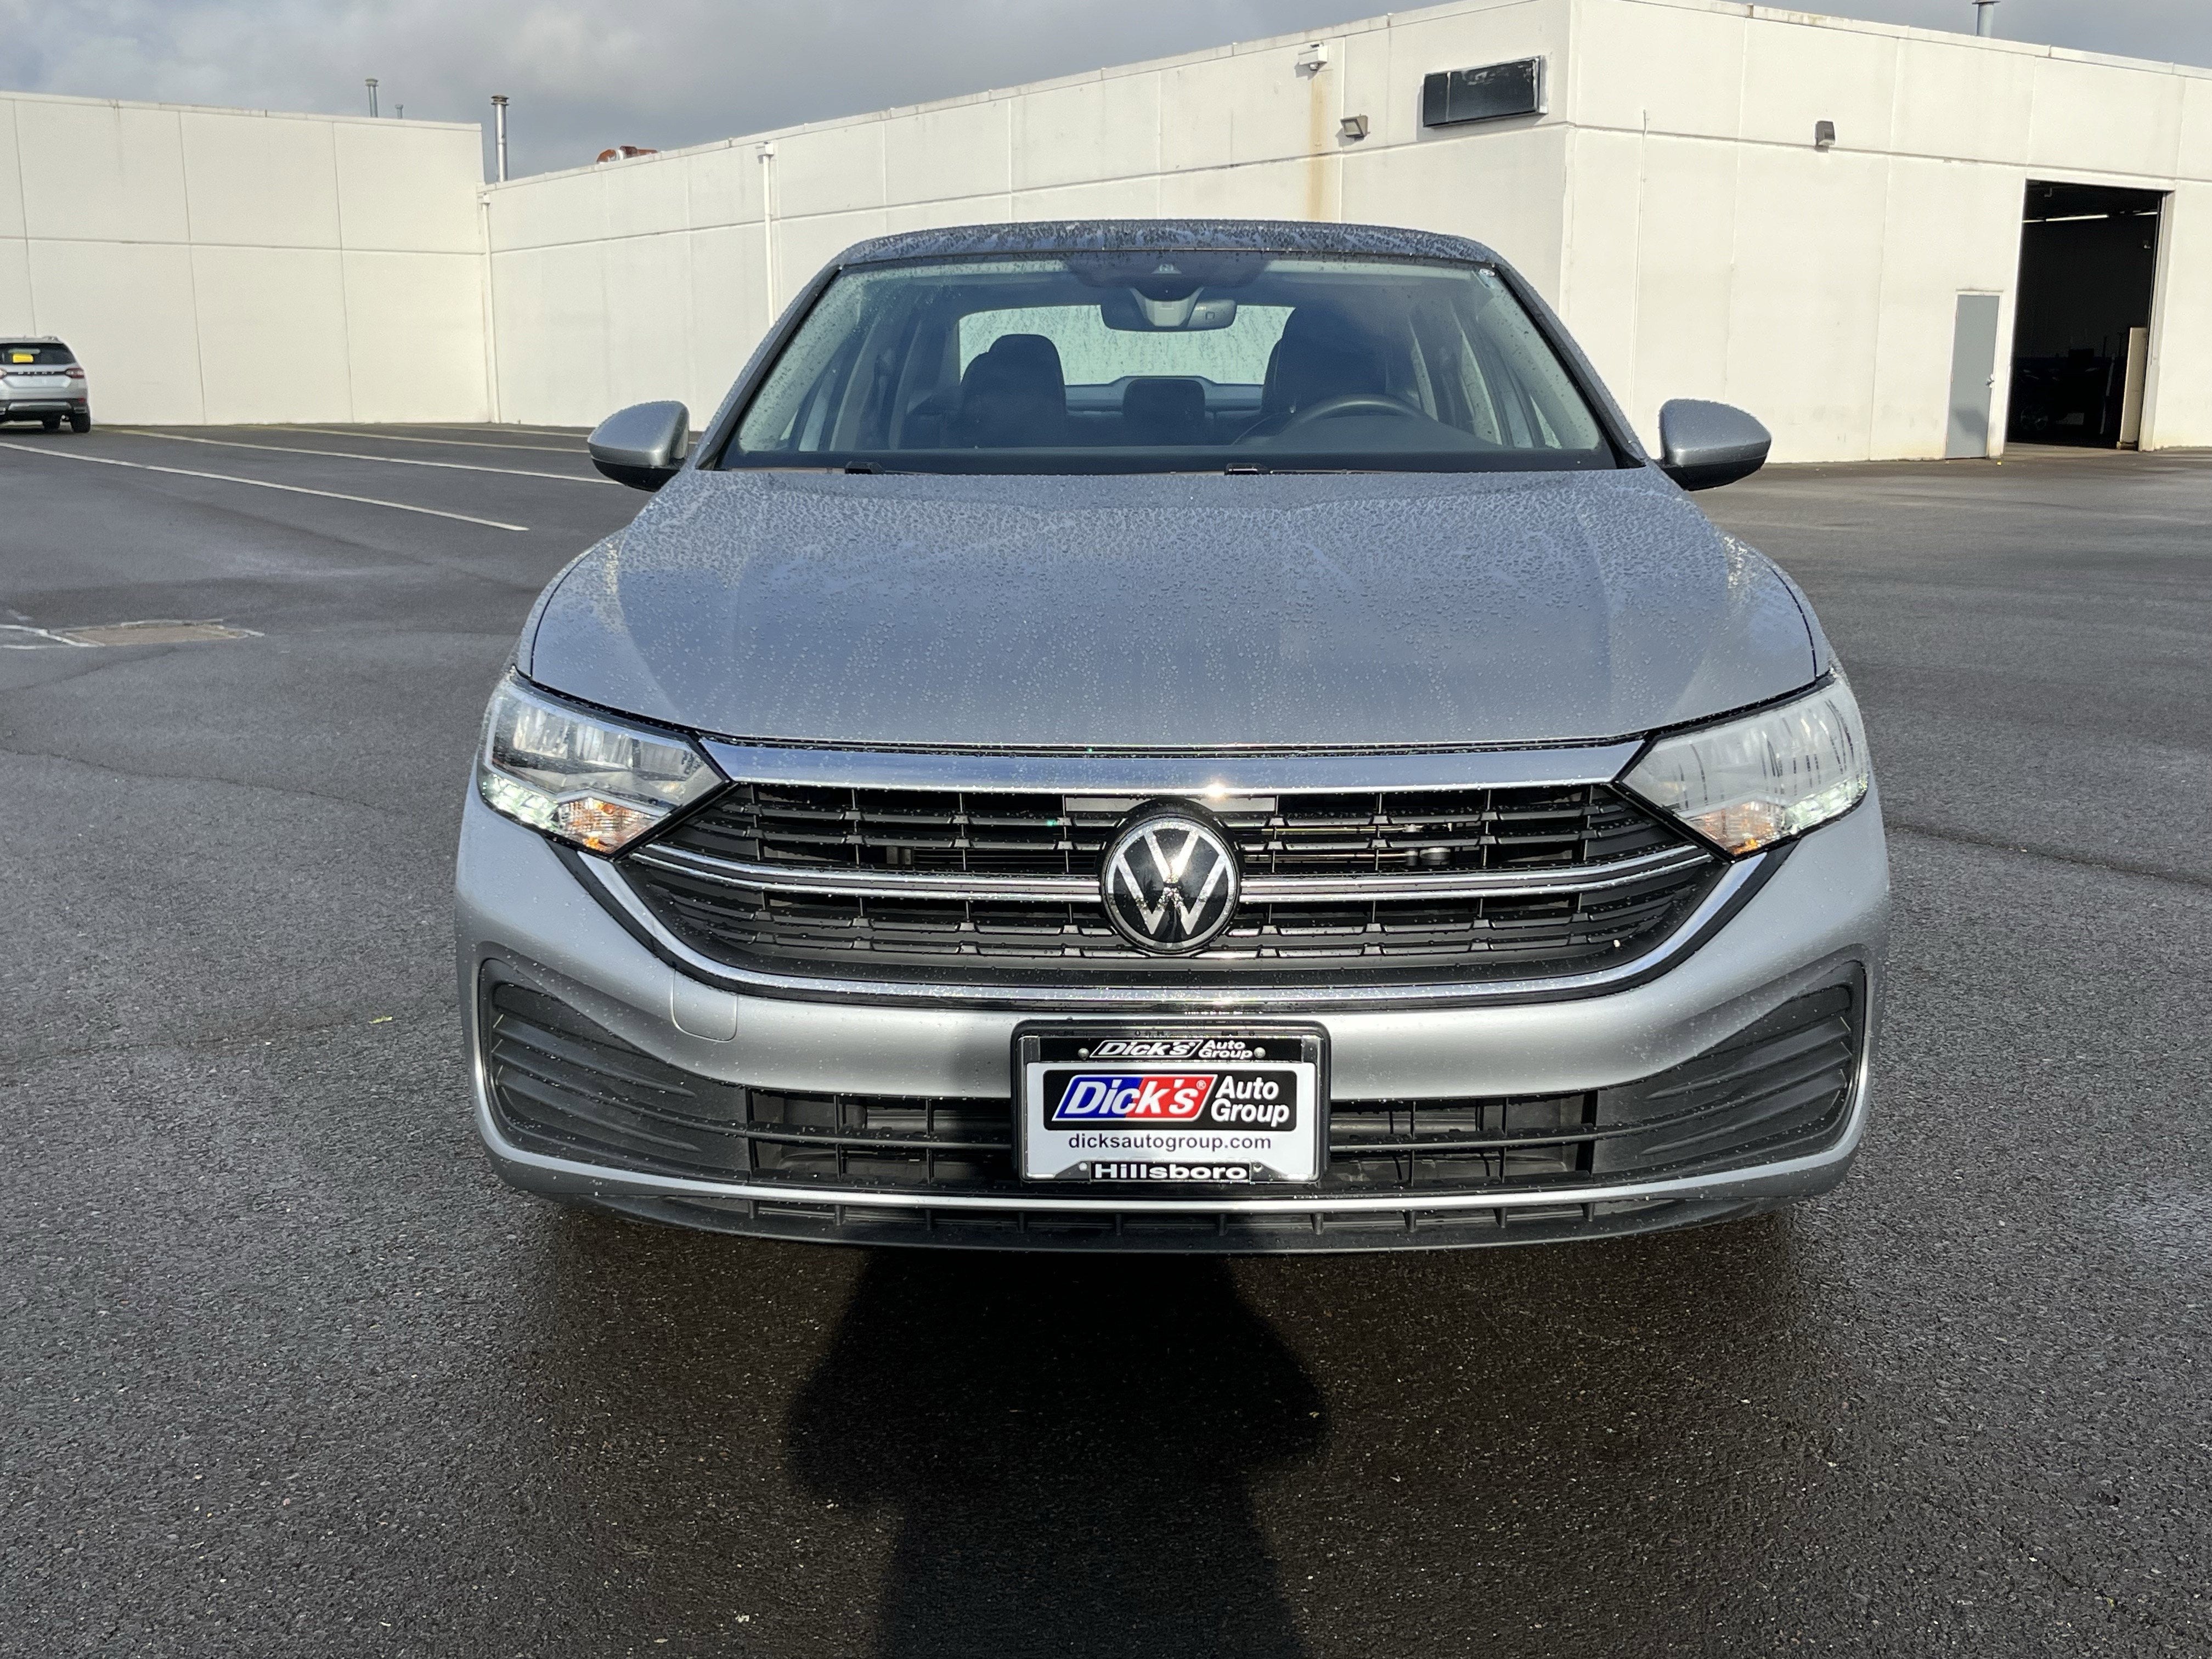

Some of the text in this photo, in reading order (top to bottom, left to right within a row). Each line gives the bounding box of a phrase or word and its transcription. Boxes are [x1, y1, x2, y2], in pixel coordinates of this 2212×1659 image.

[1098, 1041, 1190, 1056] Dick's
[1198, 1048, 1253, 1059] Group
[1203, 1040, 1246, 1050] Auto
[1215, 1075, 1279, 1100] Auto
[1064, 1079, 1199, 1115] Dick's
[1211, 1098, 1290, 1128] Group
[1068, 1133, 1272, 1152] dicksautogroup.com
[1095, 1163, 1248, 1180] Hillsboro
